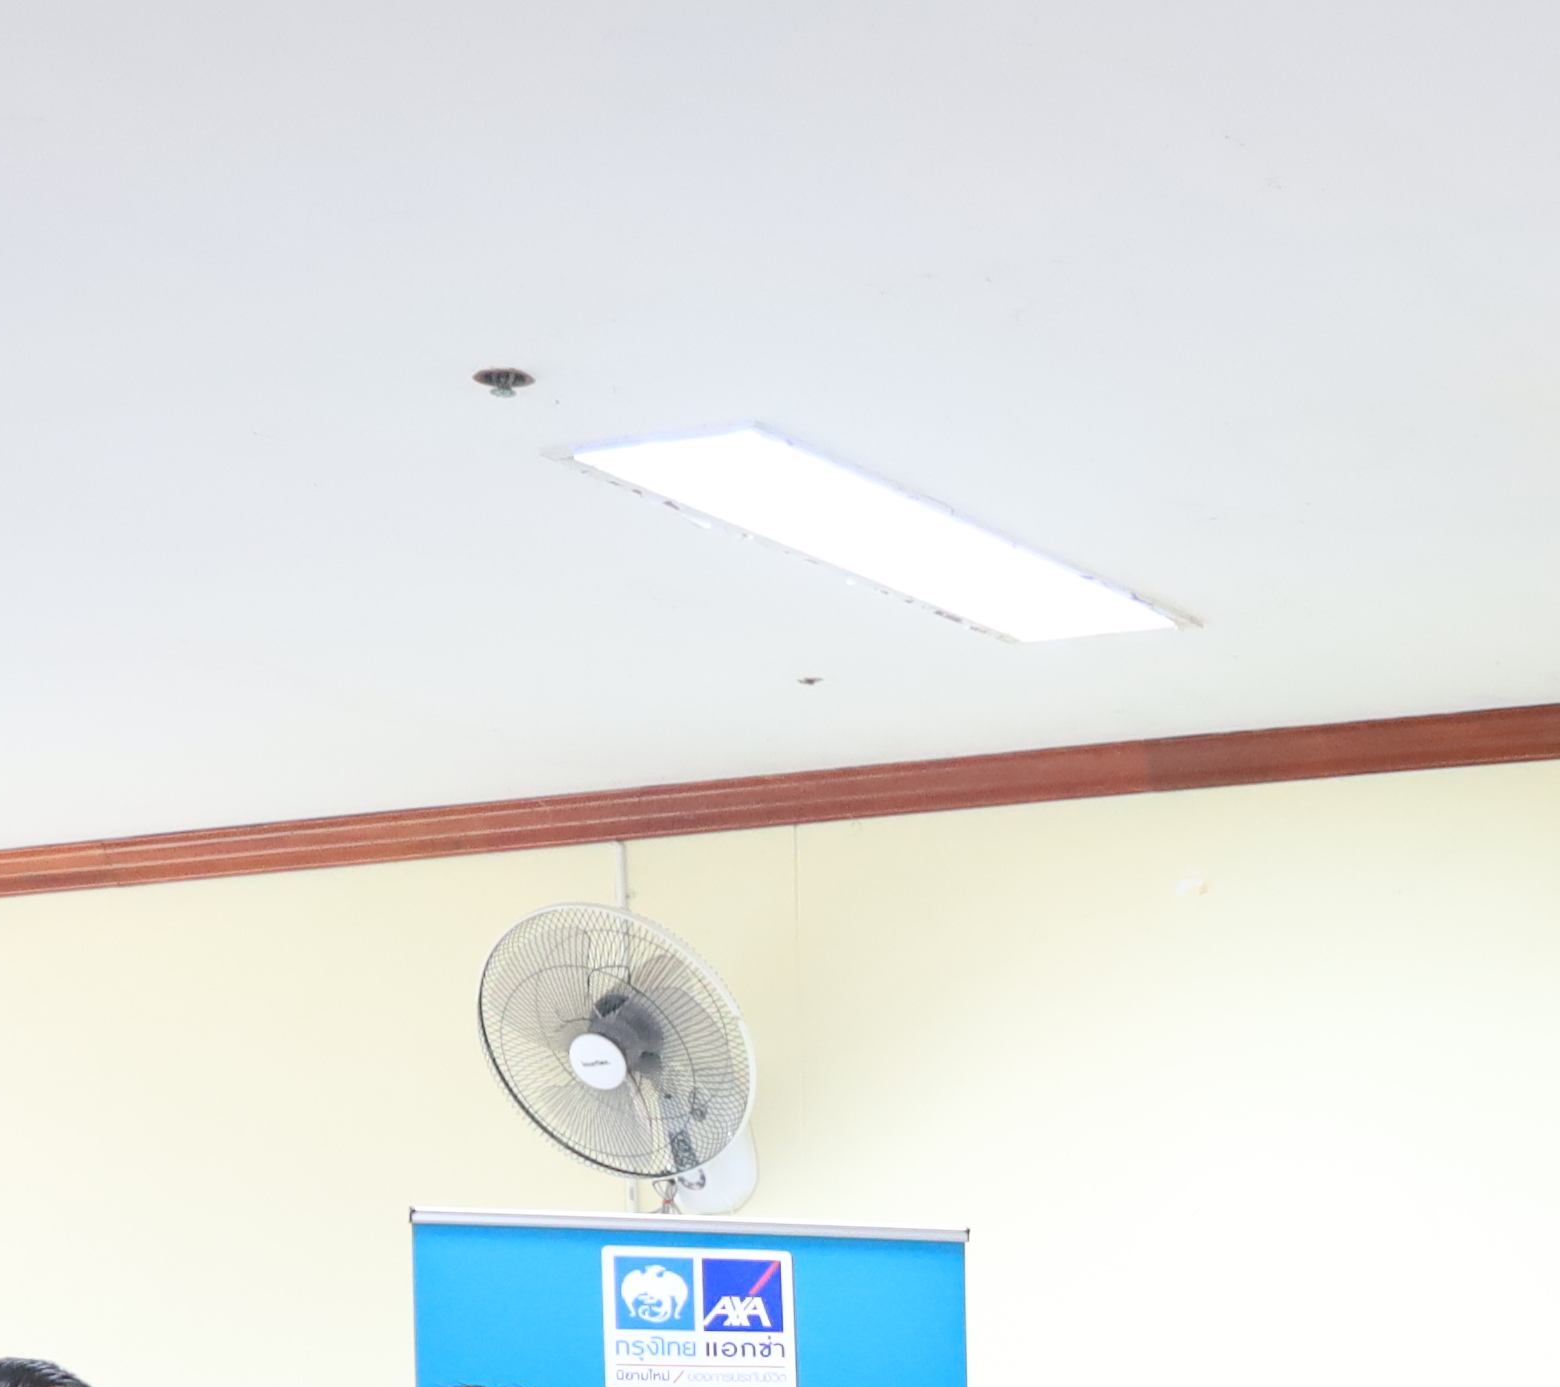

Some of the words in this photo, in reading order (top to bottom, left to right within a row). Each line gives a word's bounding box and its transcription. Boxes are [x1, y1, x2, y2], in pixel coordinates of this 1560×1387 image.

[704, 1296, 772, 1327] AXA
[616, 1336, 695, 1360] กรุงไทย
[706, 1336, 786, 1358] แอกซ่า
